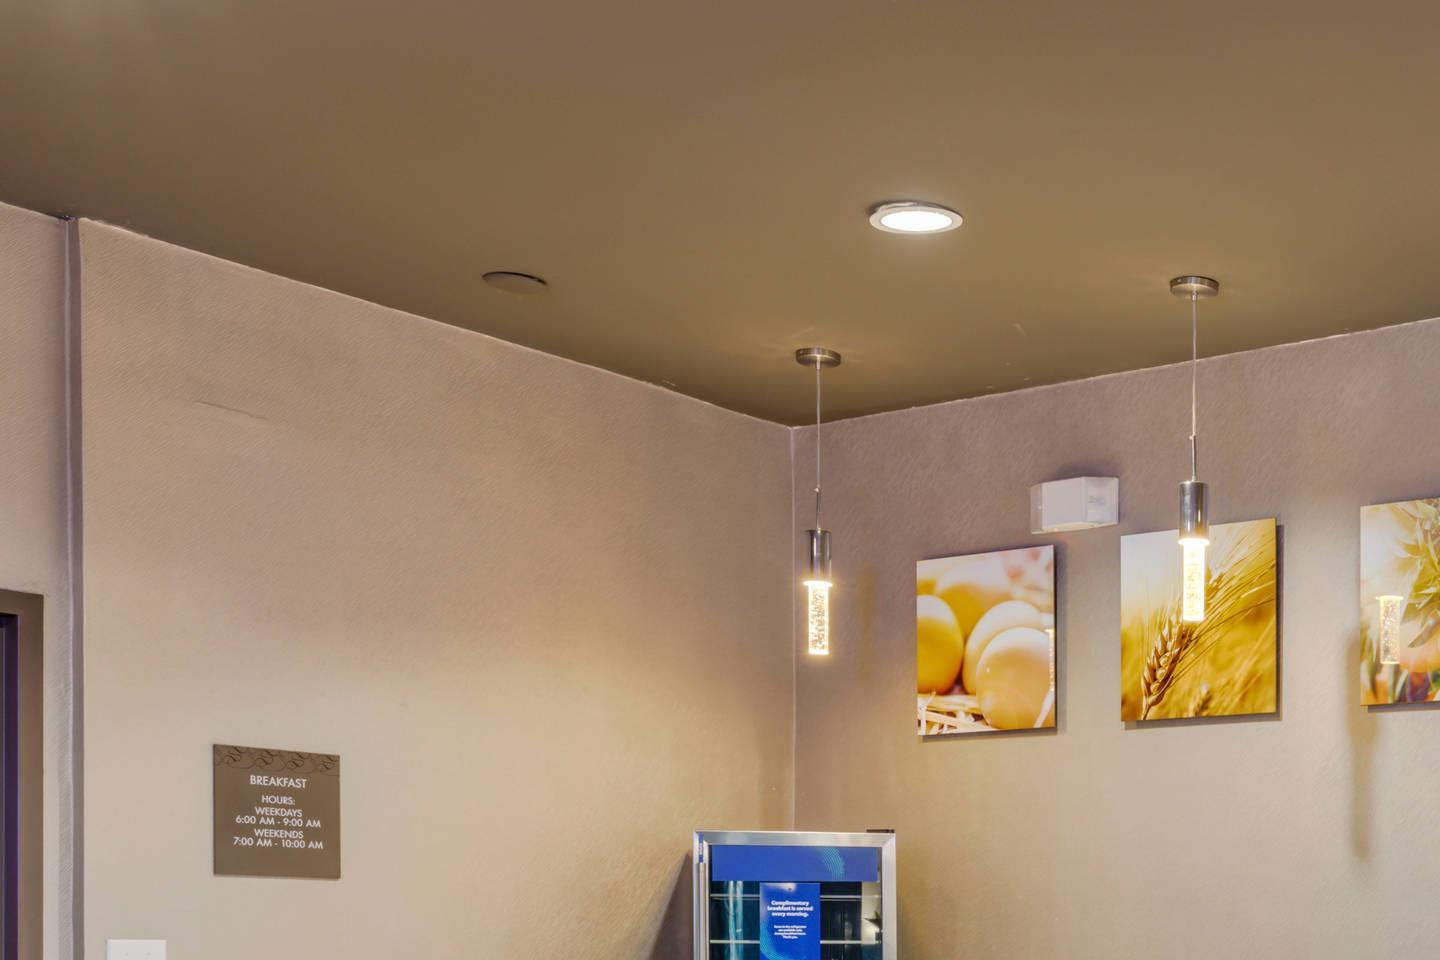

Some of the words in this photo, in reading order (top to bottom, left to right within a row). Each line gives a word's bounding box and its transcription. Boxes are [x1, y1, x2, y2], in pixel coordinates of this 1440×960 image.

[249, 774, 307, 789] BREAKFAST
[261, 794, 296, 806] HOURS:
[254, 806, 303, 818] WEEKDAYS
[235, 815, 257, 825] 6:00
[259, 816, 275, 826] AM
[282, 817, 303, 828] 9:00
[305, 819, 321, 829] AM
[253, 828, 304, 840] WEEKENDS
[232, 836, 254, 847] 7:00
[256, 838, 273, 848] AM
[281, 839, 306, 849] 10:00
[307, 840, 324, 850] AM
